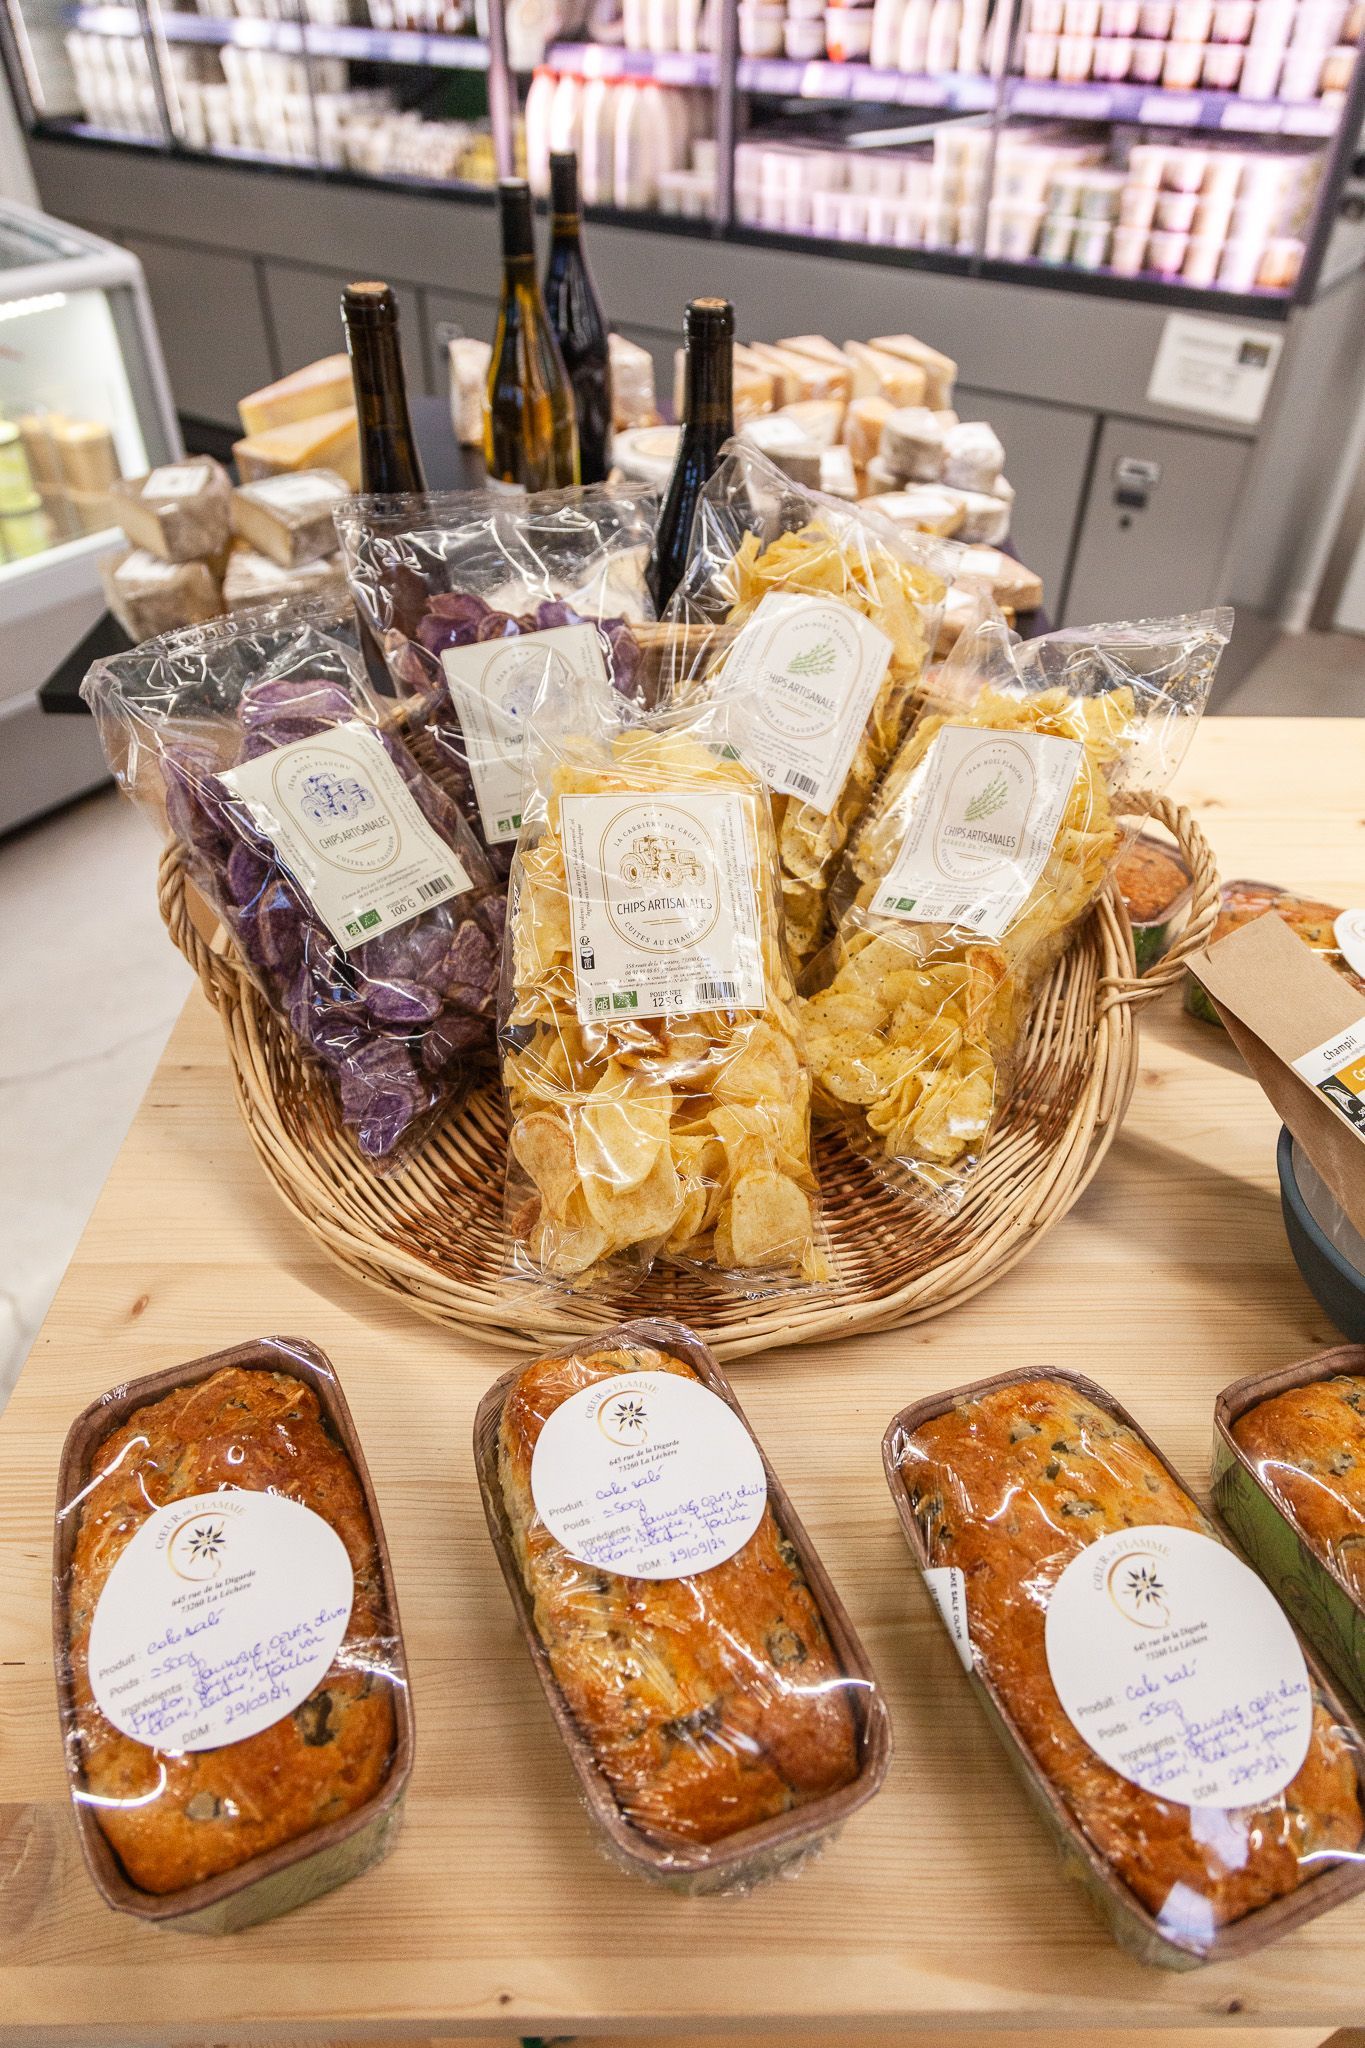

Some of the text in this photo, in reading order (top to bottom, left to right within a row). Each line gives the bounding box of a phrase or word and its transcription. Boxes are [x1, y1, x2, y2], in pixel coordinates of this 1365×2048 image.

[504, 734, 524, 747] CHIP
[319, 815, 390, 849] CHIPS ARTISANALES
[614, 837, 623, 847] LA
[664, 822, 675, 830] DE
[678, 828, 701, 846] CRUET
[944, 825, 1016, 848] CHIPS ARTISANALES
[390, 904, 408, 917] 100
[407, 898, 417, 909] G
[617, 900, 646, 915] CHIPS
[624, 921, 650, 943] CUITES
[649, 990, 669, 998] POIDS
[652, 996, 672, 1008] 125
[674, 994, 683, 1005] G
[1323, 1035, 1358, 1061] Champii
[623, 1453, 635, 1461] rue
[636, 1449, 644, 1457] de
[548, 1499, 584, 1516] Produit
[631, 1465, 664, 1488] salé
[563, 1516, 591, 1532] Poids
[636, 1538, 726, 1573] DDM 29/09/24
[950, 1567, 958, 1588] CAKE
[188, 1590, 202, 1599] rue
[204, 1584, 213, 1593] de
[215, 1580, 223, 1588] la
[951, 1591, 960, 1611] SALE
[98, 1653, 136, 1680] Produit
[110, 1677, 140, 1698] Poids
[1077, 1696, 1115, 1717] Produit
[181, 1724, 210, 1744] DDM
[1098, 1723, 1128, 1739] Poids
